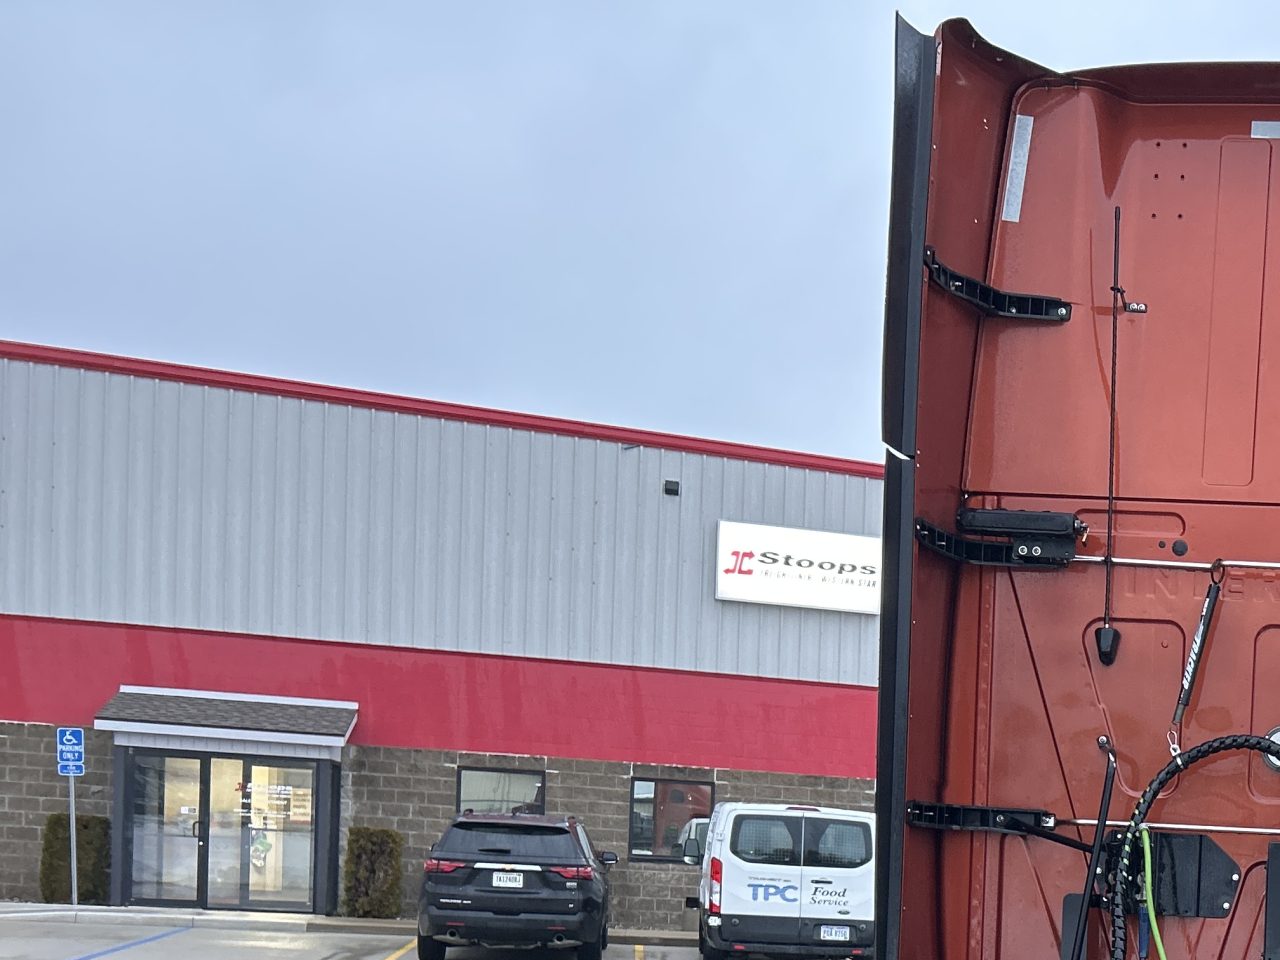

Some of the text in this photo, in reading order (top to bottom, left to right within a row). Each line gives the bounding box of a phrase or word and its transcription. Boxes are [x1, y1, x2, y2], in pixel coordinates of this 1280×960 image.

[757, 551, 877, 575] Stoops
[62, 752, 79, 760] ONLY
[747, 883, 799, 903] TPC
[811, 886, 848, 898] Food
[809, 896, 849, 907] Service
